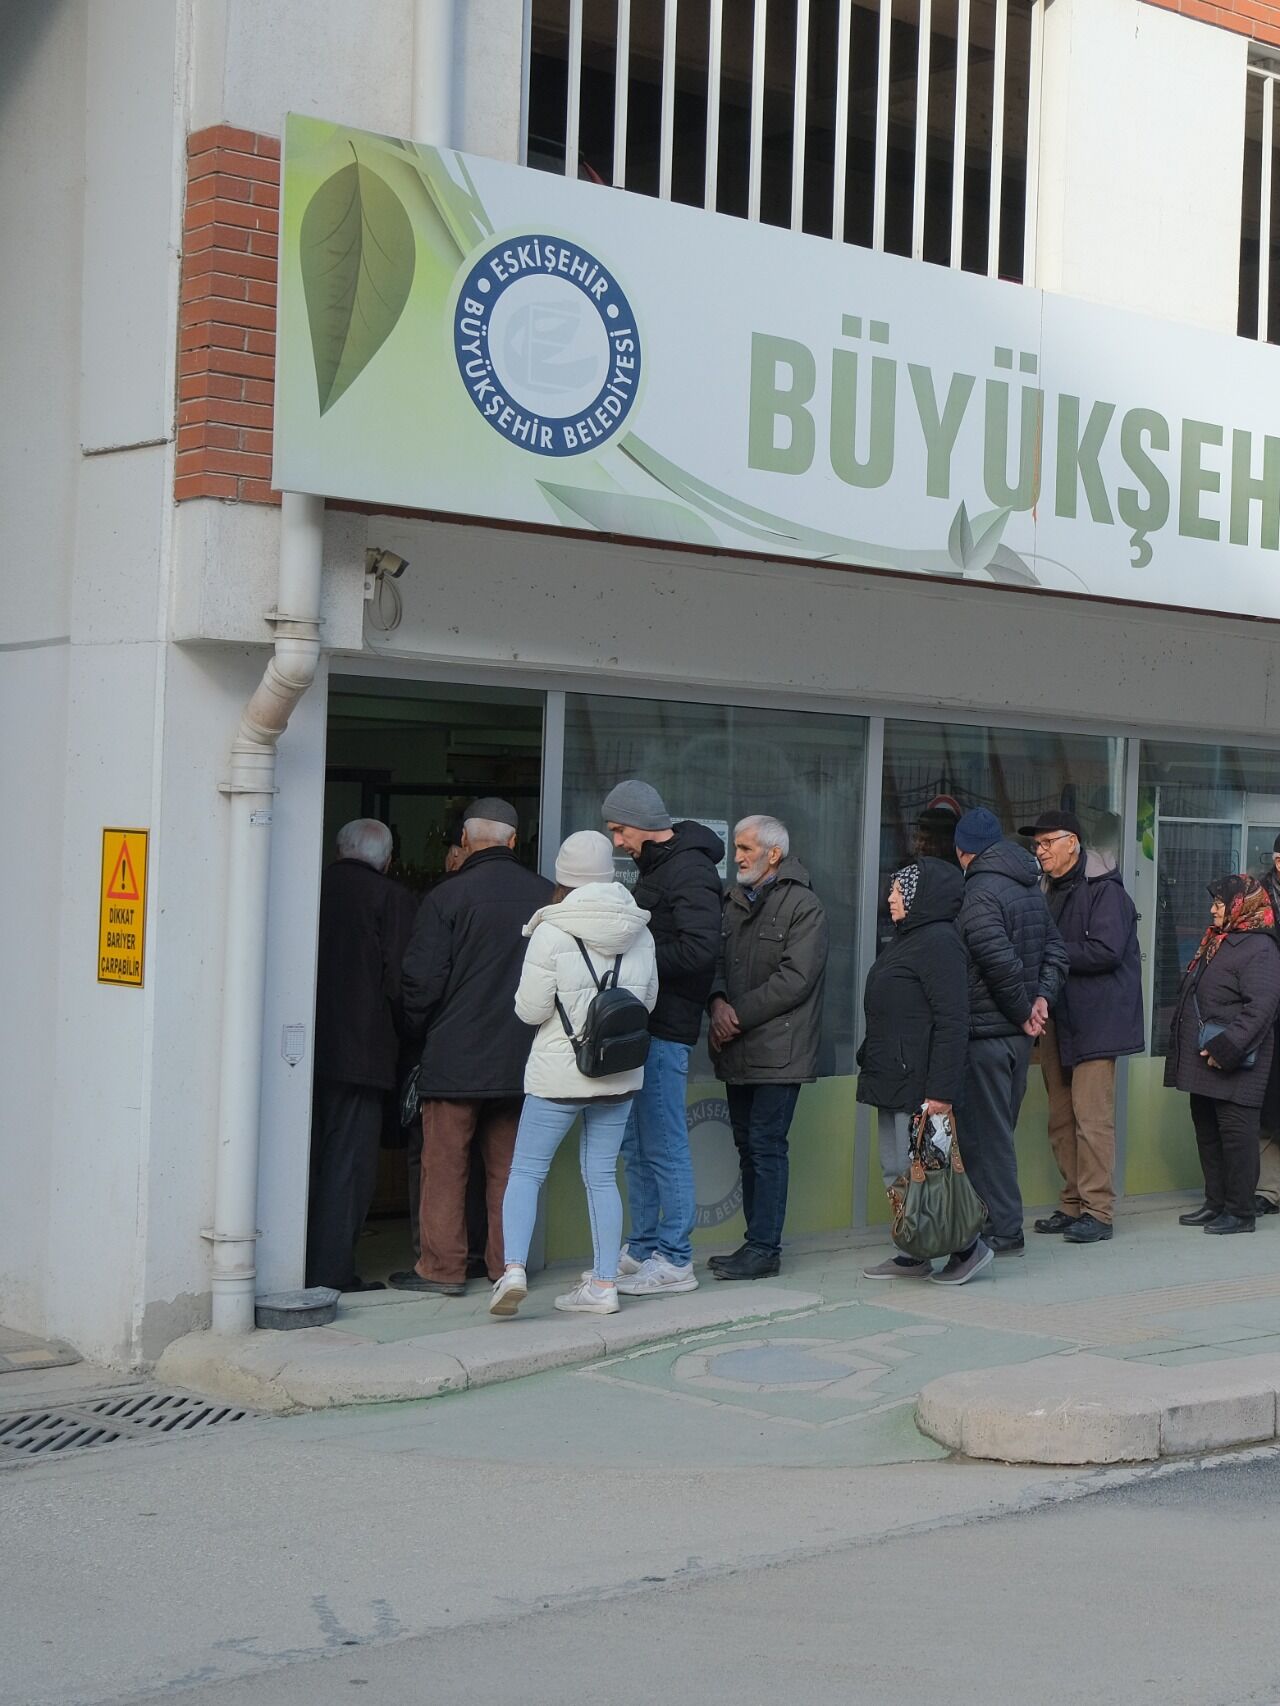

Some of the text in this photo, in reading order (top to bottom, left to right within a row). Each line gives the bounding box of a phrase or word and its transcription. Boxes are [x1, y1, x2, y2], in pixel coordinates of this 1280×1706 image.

[490, 239, 609, 300] ESKİŞEHİR
[460, 297, 635, 449] BÜYÜKŞEHİR BELEDİYESİ
[109, 904, 134, 925] DİKKAT
[107, 929, 136, 950] BARİYER
[101, 953, 140, 977] ÇARPABİLİR
[686, 1102, 730, 1126] SKİŞEH
